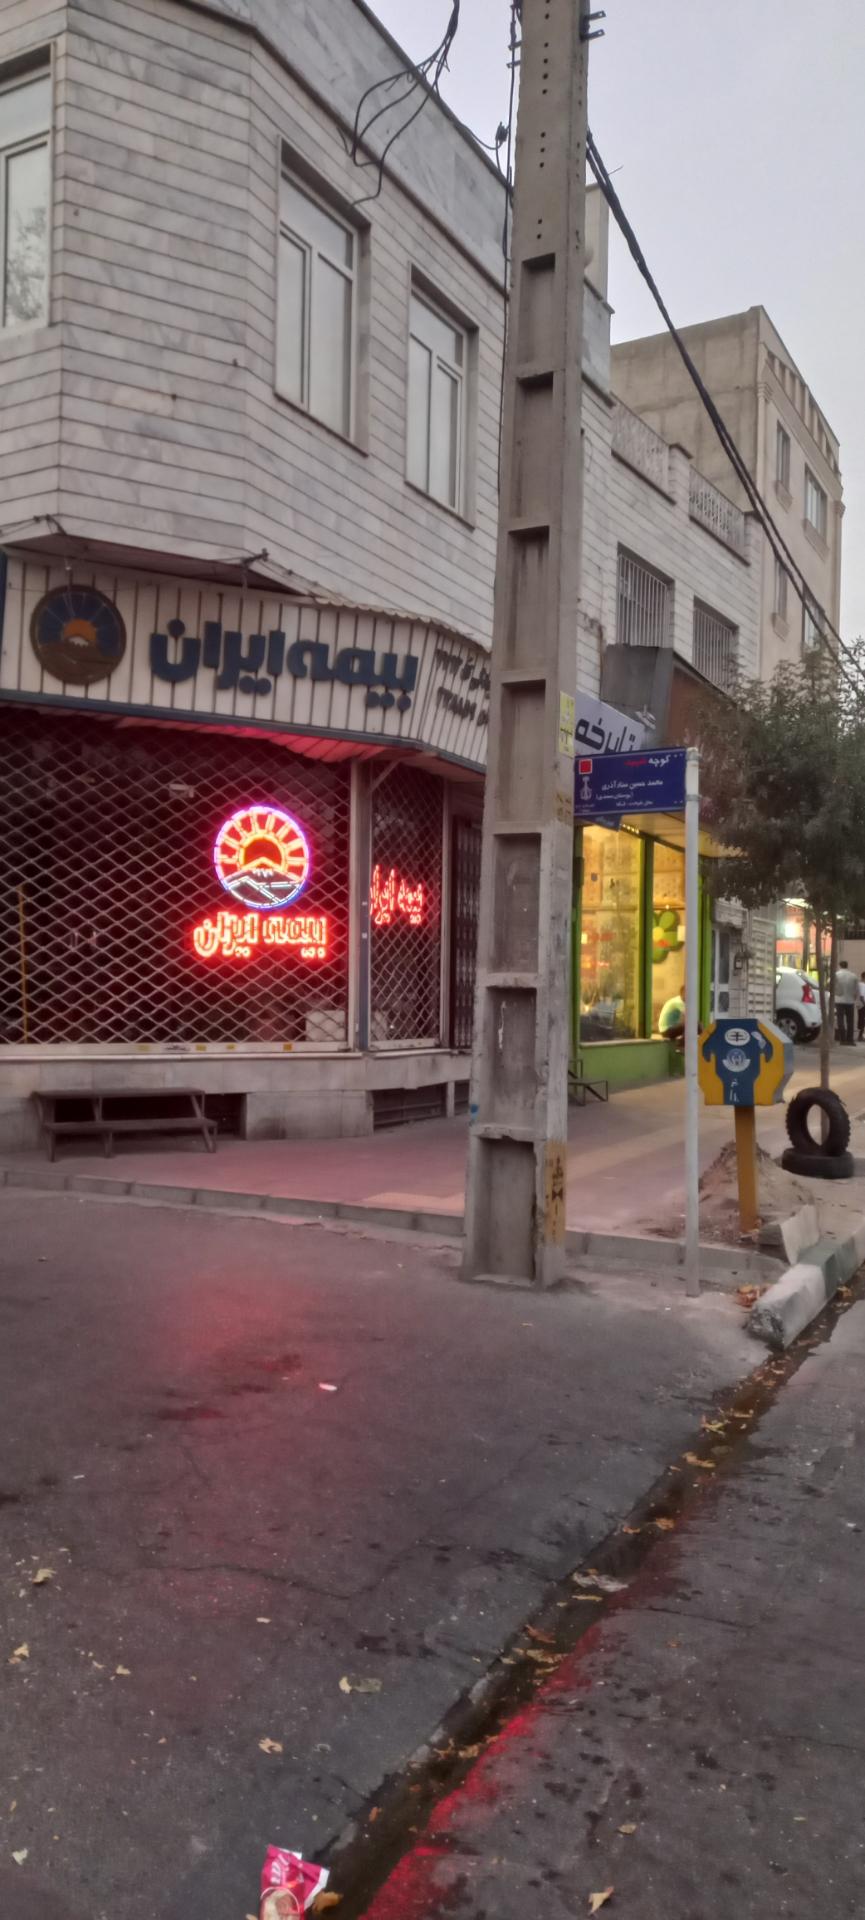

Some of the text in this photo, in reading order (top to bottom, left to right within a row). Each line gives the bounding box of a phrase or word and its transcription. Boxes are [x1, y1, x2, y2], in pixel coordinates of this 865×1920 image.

[150, 618, 286, 696] ایران
[287, 639, 419, 712] بیمه
[647, 779, 664, 787] محمد
[648, 754, 671, 768] کوچه
[370, 864, 423, 926] بیمه ایرا
[192, 910, 328, 960] بیمه ایران
